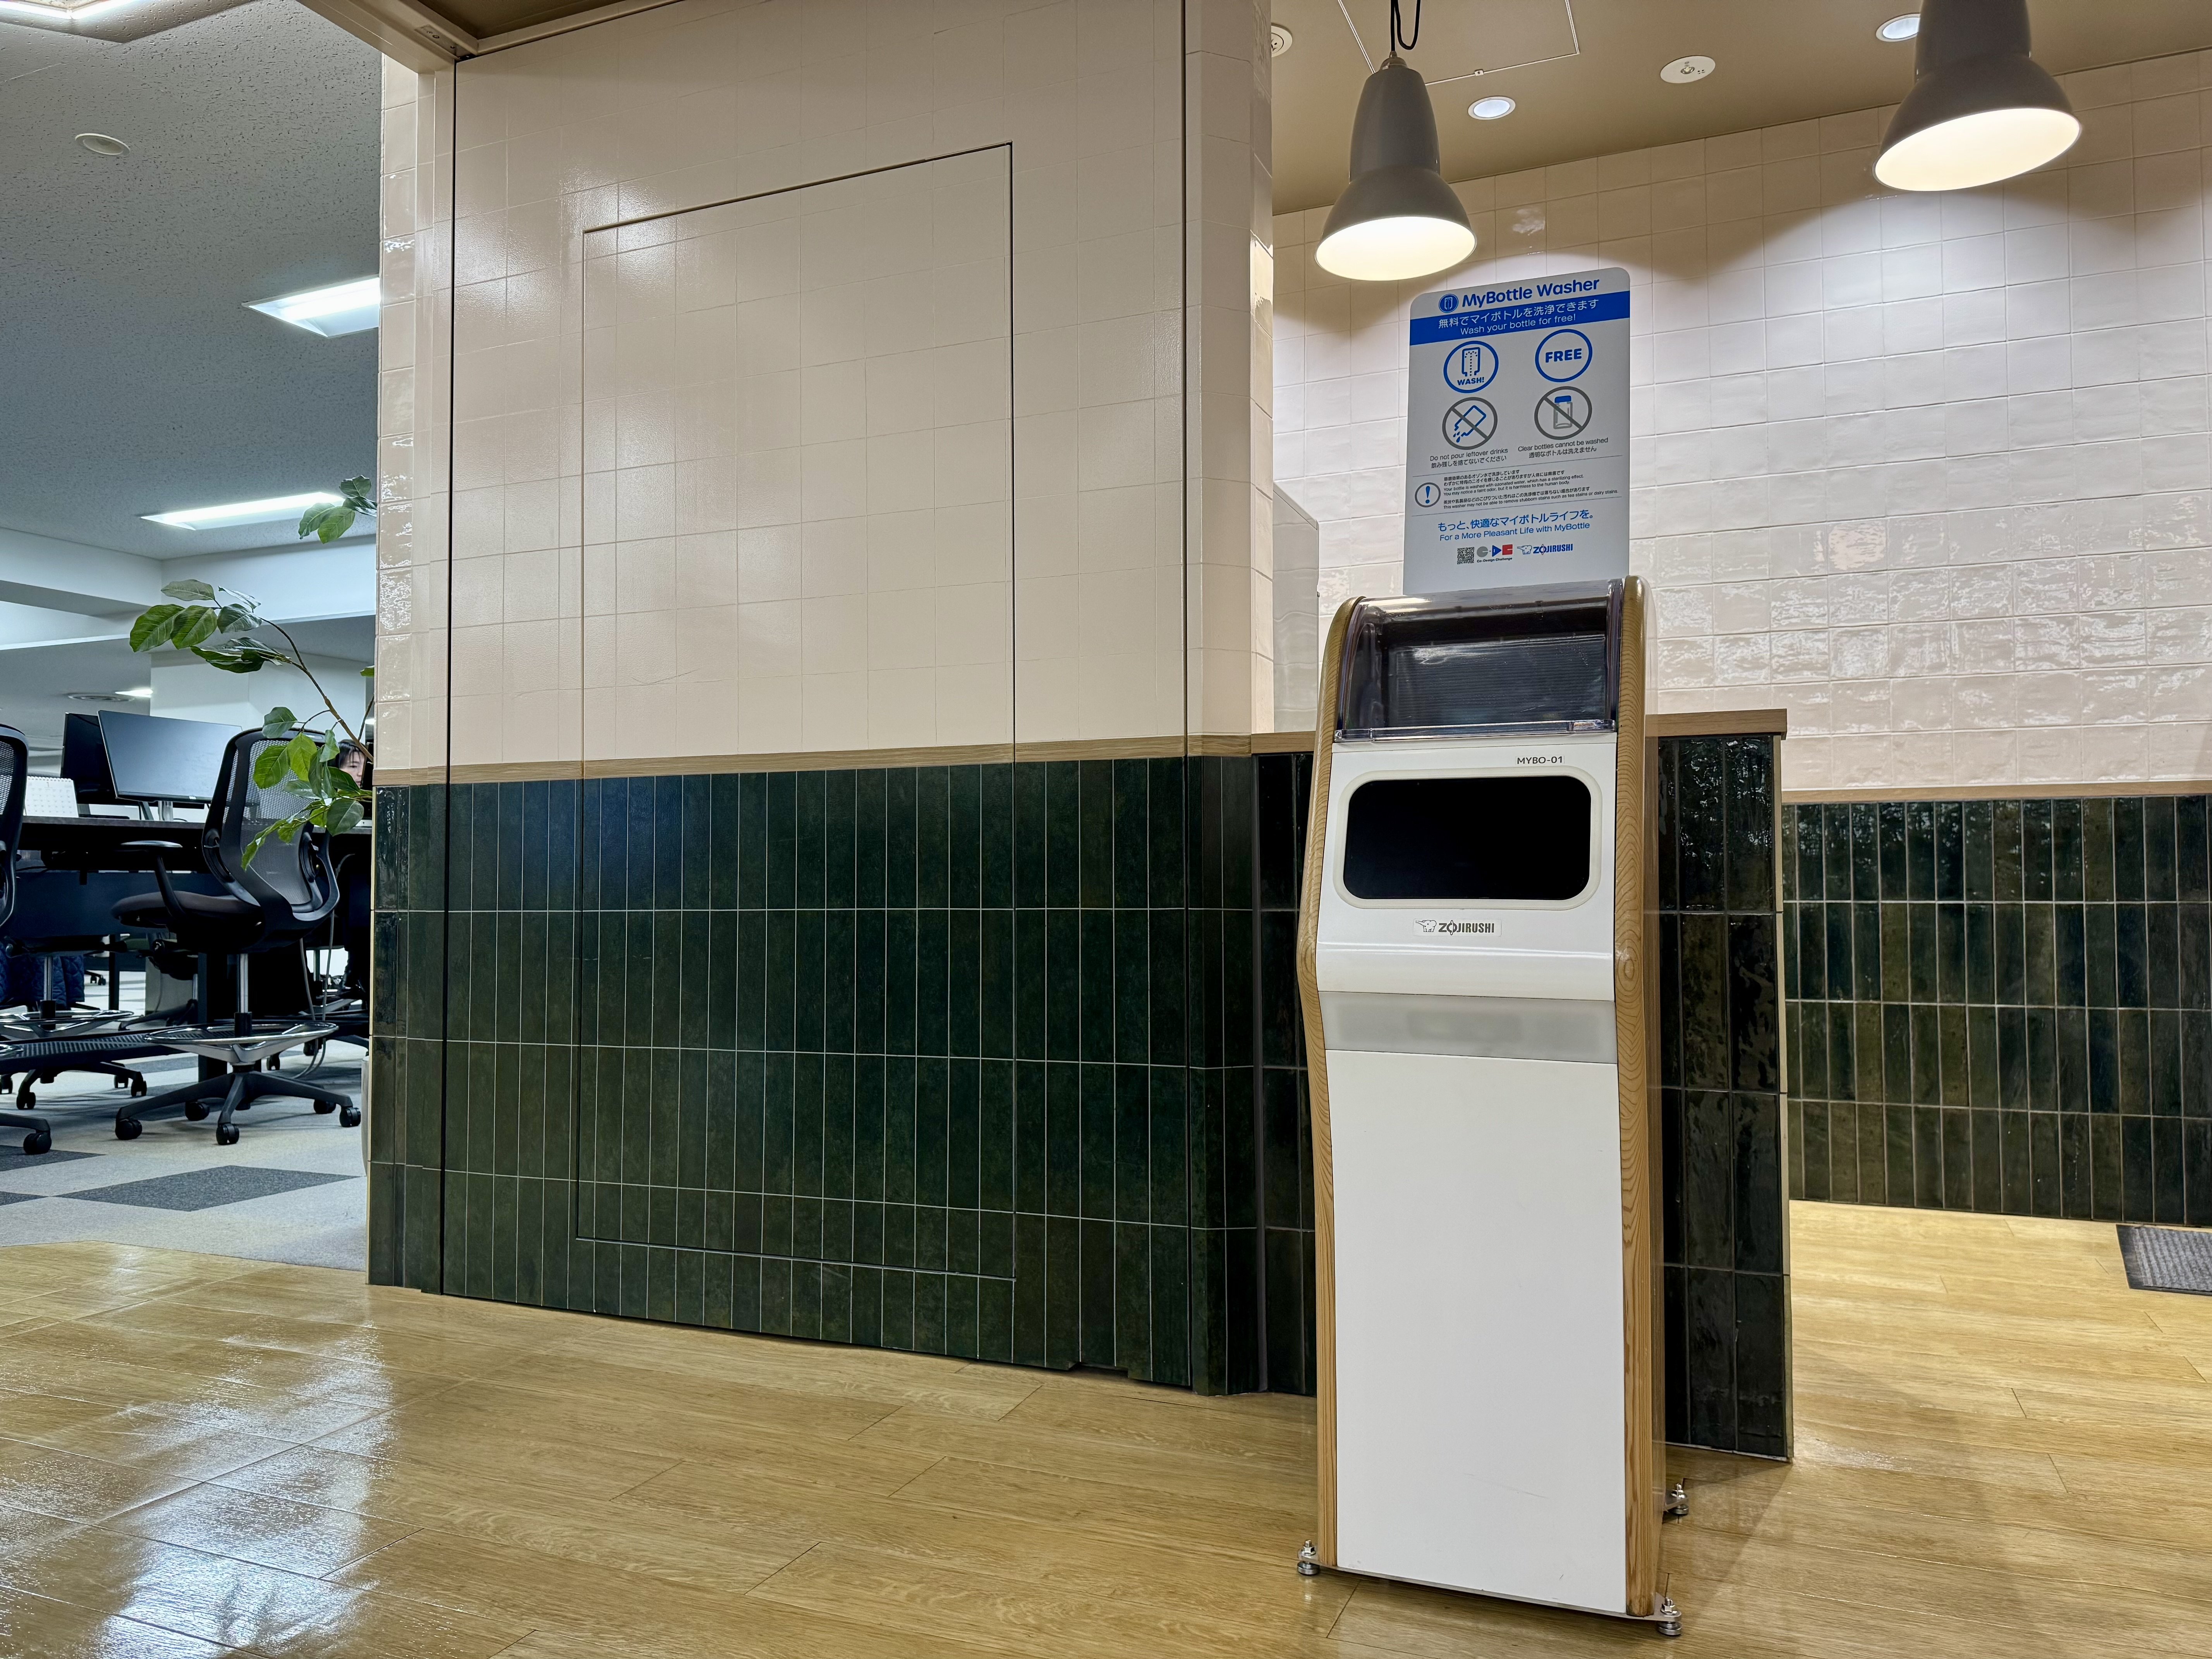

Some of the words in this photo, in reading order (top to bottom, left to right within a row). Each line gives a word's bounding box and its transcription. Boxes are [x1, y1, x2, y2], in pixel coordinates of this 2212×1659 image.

[1462, 287, 1532, 308] MyBottle
[1537, 279, 1599, 297] Washer
[1438, 299, 1599, 328] 無料でマイボトルを洗浄できます
[1461, 326, 1484, 335] Wash
[1487, 324, 1507, 333] your
[1510, 319, 1536, 328] bottle
[1554, 314, 1575, 323] free!
[1545, 348, 1582, 363] FREE
[1457, 376, 1484, 386] WASH!
[1529, 446, 1597, 458] 透明なボトルは洗えません
[1431, 455, 1506, 468] 飲み残しを捨てないでください
[1438, 509, 1593, 531] もっと、快適なマイボトルライフを。
[1484, 528, 1517, 537] Pleasant
[1554, 522, 1590, 531] MyBottle
[1533, 544, 1573, 555] ZOJIRUSHI
[1517, 756, 1562, 764] MYBO-01
[1438, 920, 1494, 936] ZOJIRUSHI
